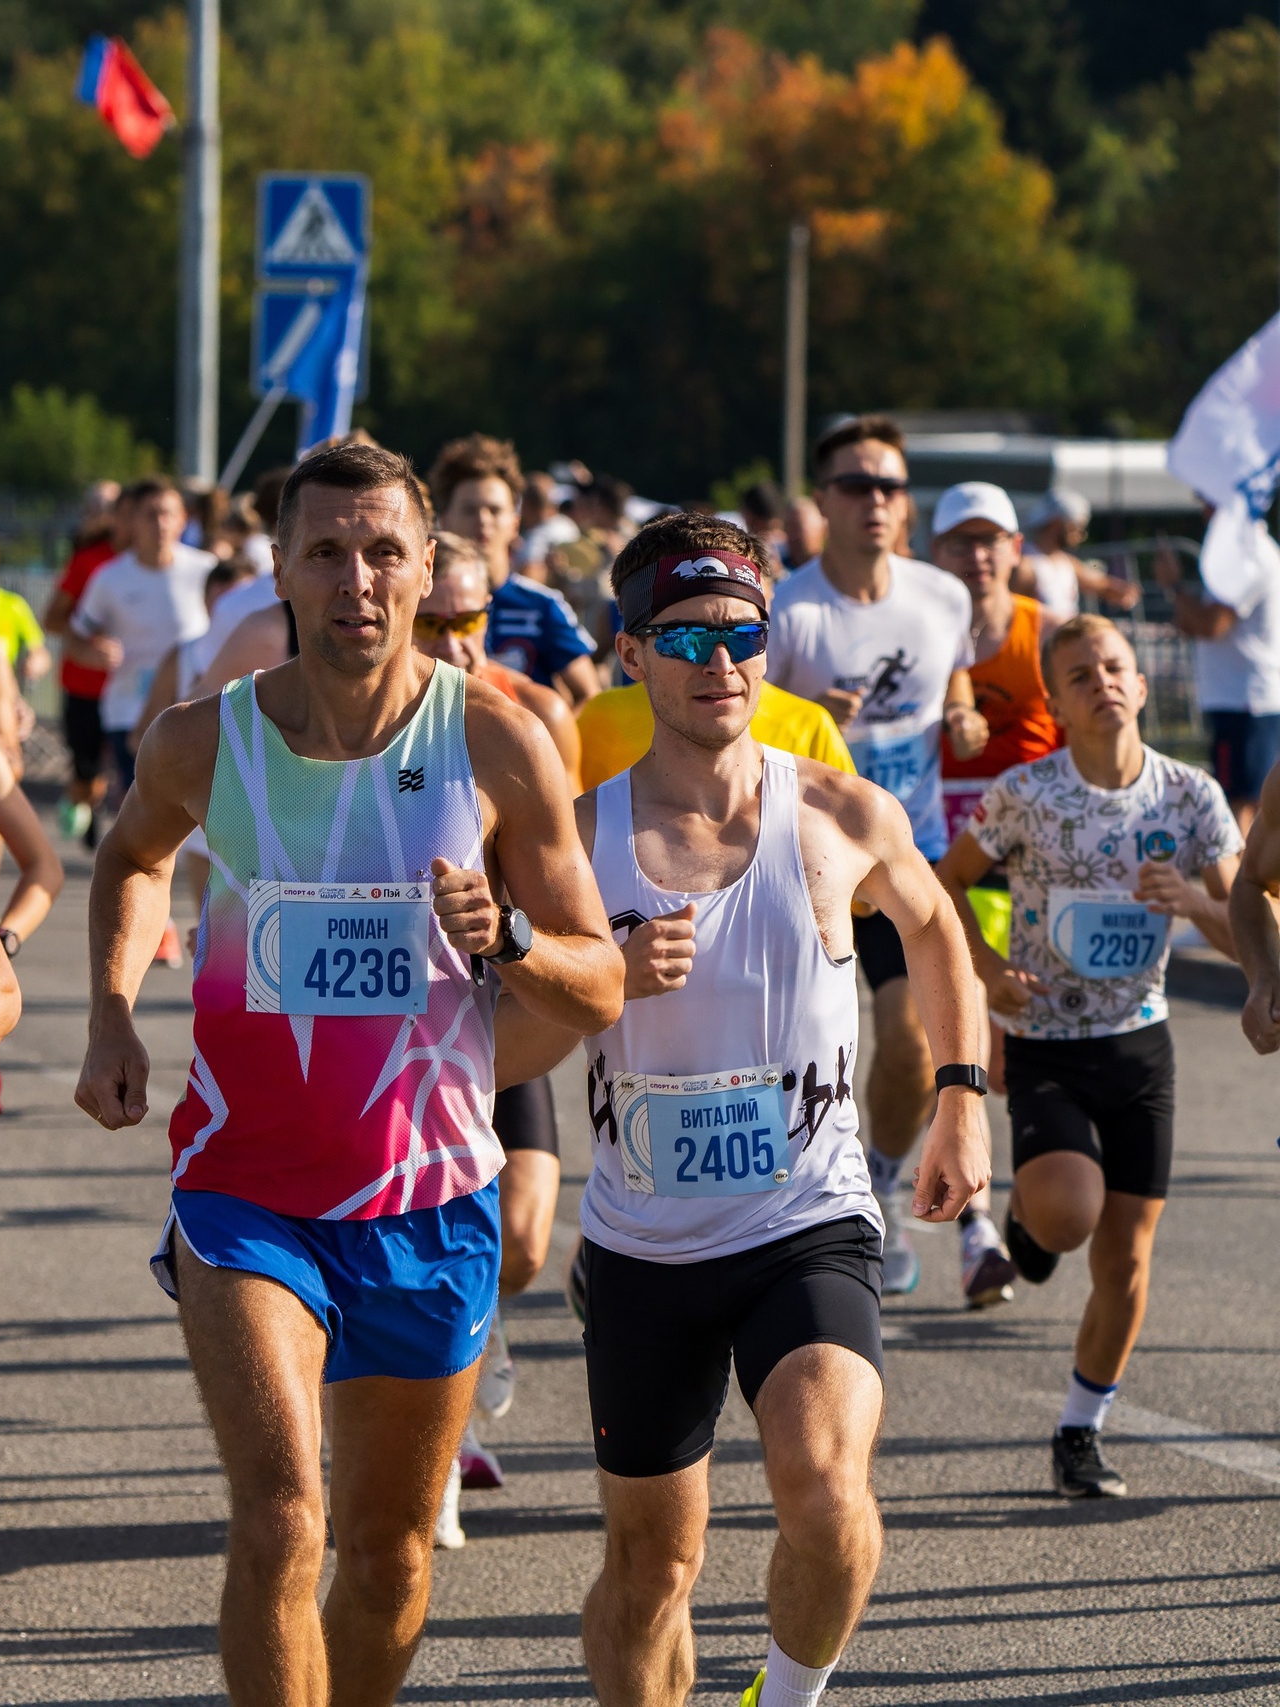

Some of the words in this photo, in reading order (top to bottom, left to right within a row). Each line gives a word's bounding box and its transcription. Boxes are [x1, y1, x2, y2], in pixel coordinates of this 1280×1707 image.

[383, 888, 400, 898] Пэй
[328, 918, 388, 939] РОМАН
[1088, 932, 1155, 968] 2297
[304, 947, 411, 998] 4236
[742, 1074, 757, 1084] Пэй
[680, 1098, 759, 1129] ВИТАЛИЙ
[674, 1127, 775, 1183] 2405
